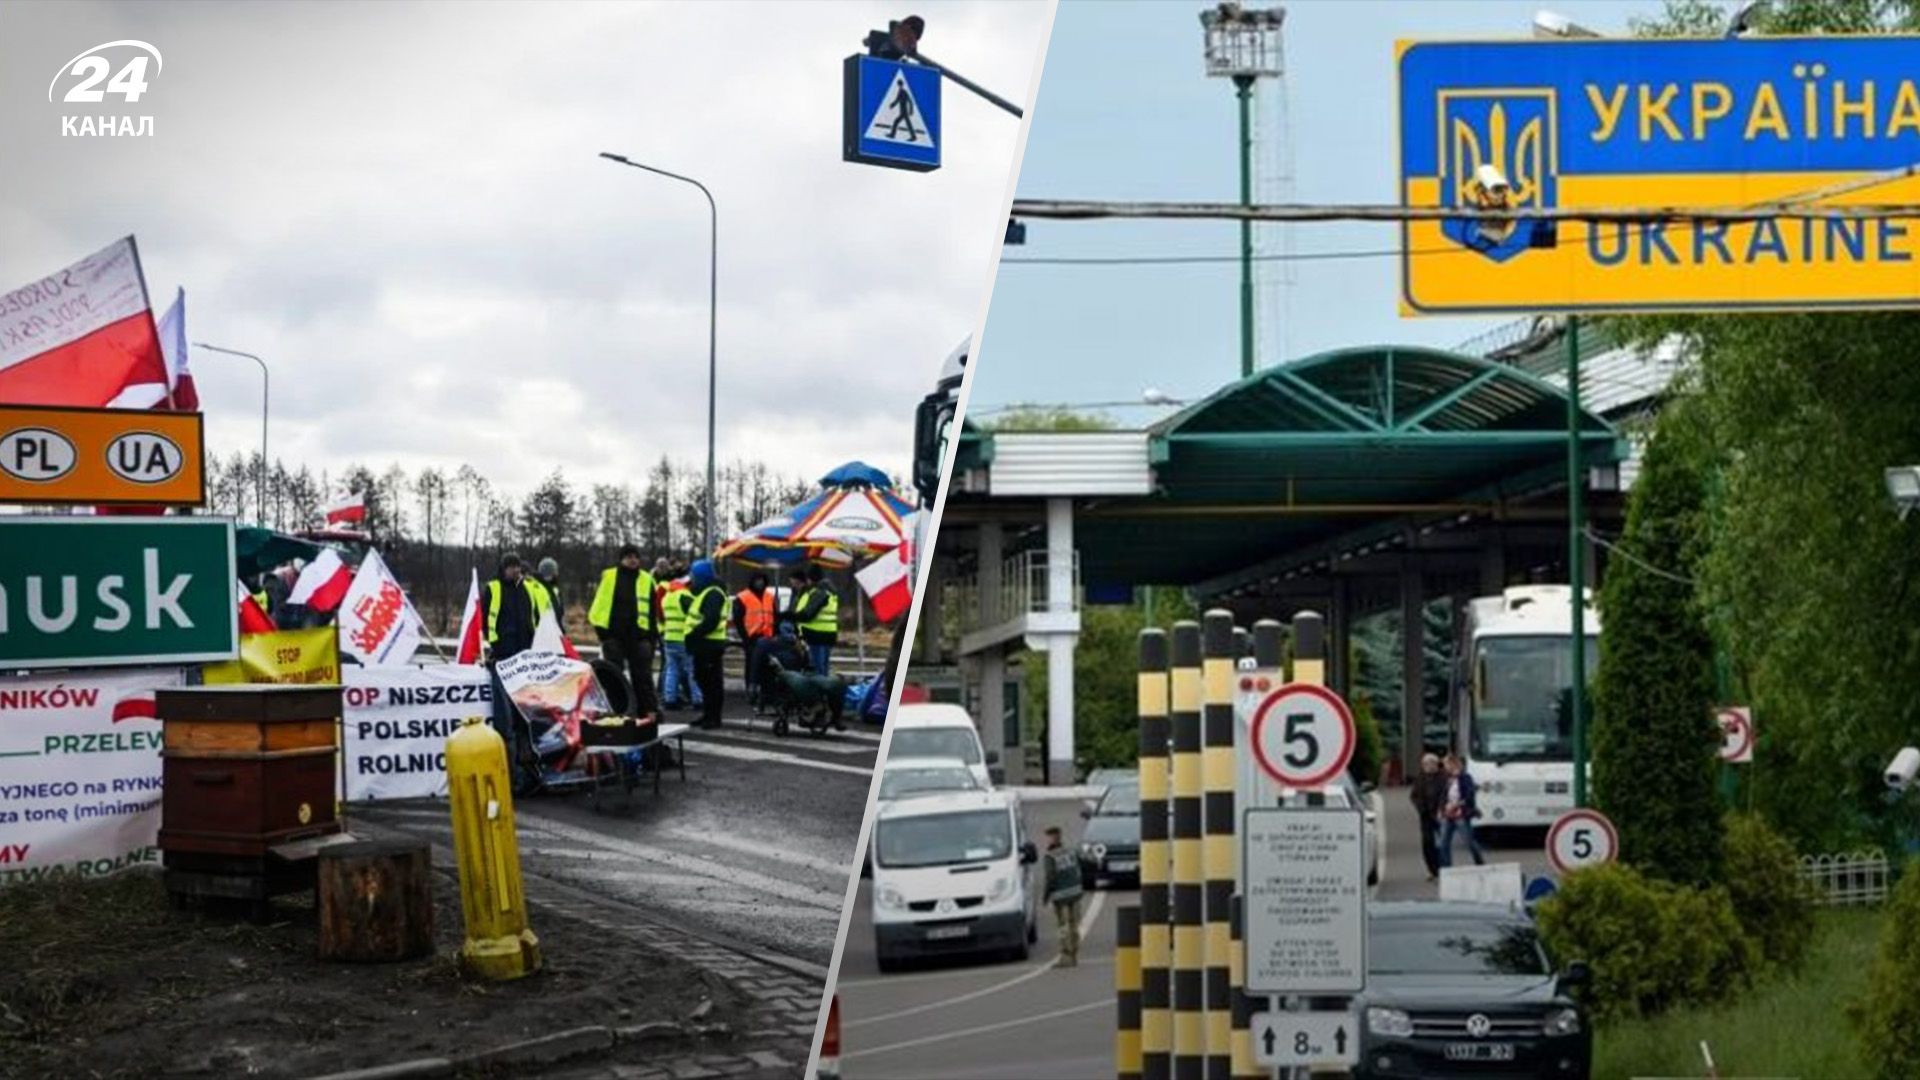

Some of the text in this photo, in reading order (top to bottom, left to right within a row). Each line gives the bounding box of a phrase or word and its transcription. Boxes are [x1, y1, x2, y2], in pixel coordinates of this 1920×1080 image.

[1584, 63, 1920, 142] УКРАЇНА
[1585, 212, 1912, 265] UKRAINE
[15, 438, 59, 472] PL
[119, 440, 170, 474] UA
[276, 647, 300, 665] STOP
[0, 683, 99, 709] NIKÓW
[342, 686, 380, 706] OP
[1283, 712, 1319, 769] 5
[84, 782, 107, 795] na
[0, 810, 18, 824] za
[25, 807, 68, 823] tonę
[1573, 829, 1592, 859] 5
